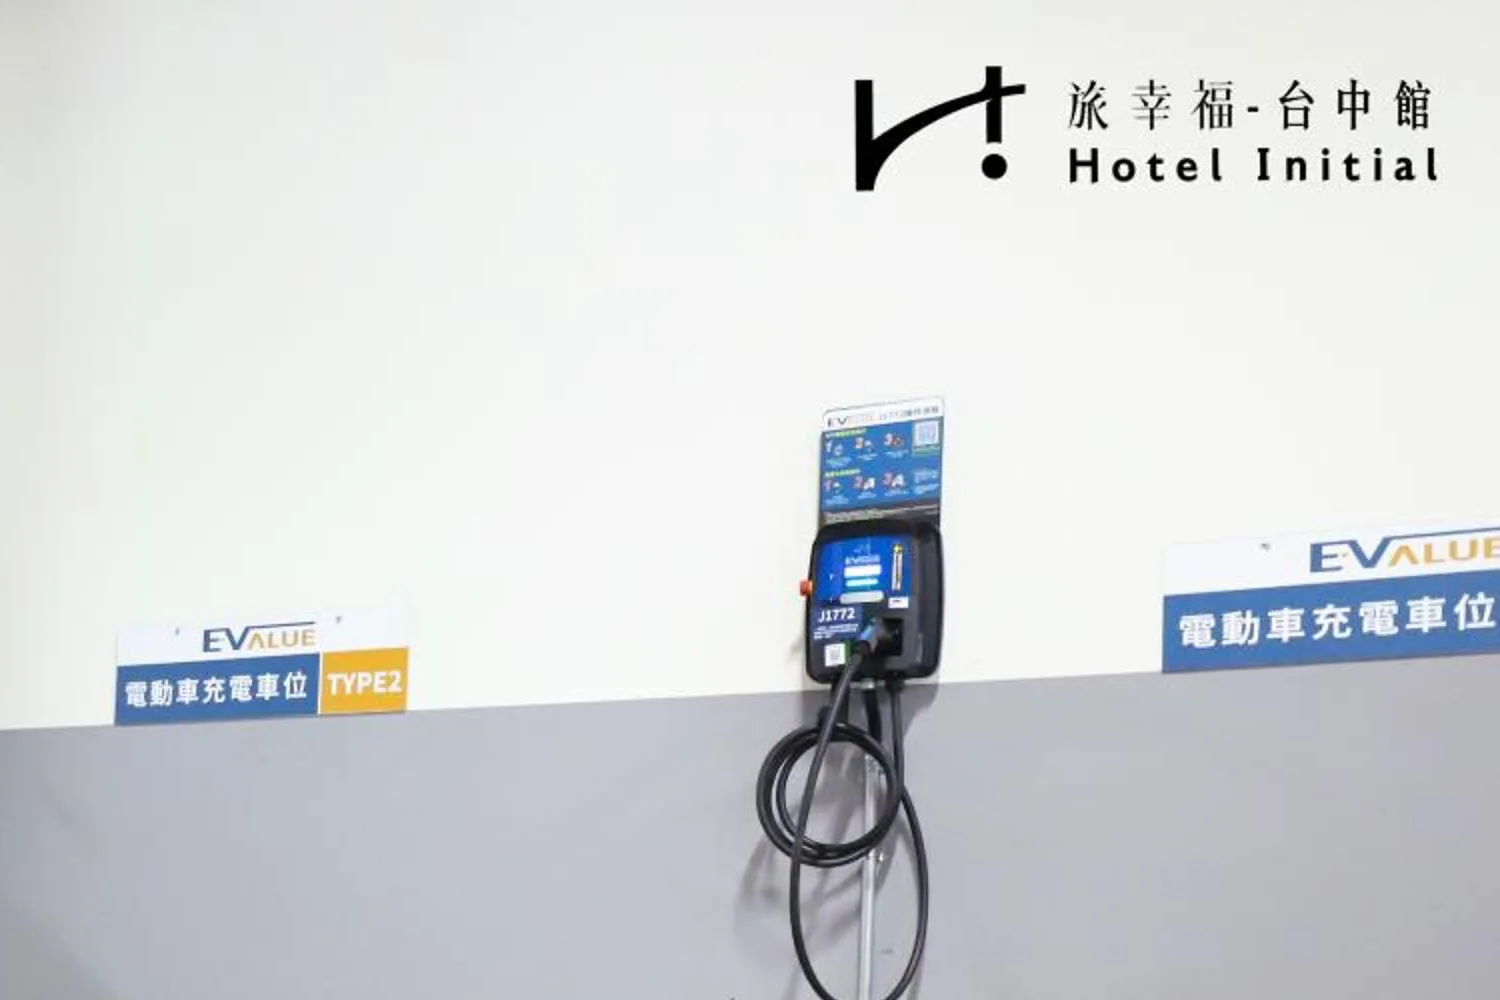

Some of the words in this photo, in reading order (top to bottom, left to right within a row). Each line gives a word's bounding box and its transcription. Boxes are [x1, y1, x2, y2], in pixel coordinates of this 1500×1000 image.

[818, 607, 855, 622] J1772
[1178, 591, 1497, 649] 電動車充電車位
[203, 621, 316, 653] EVALUE
[124, 671, 308, 708] 電動車充電車位
[327, 669, 403, 696] TYPE2
